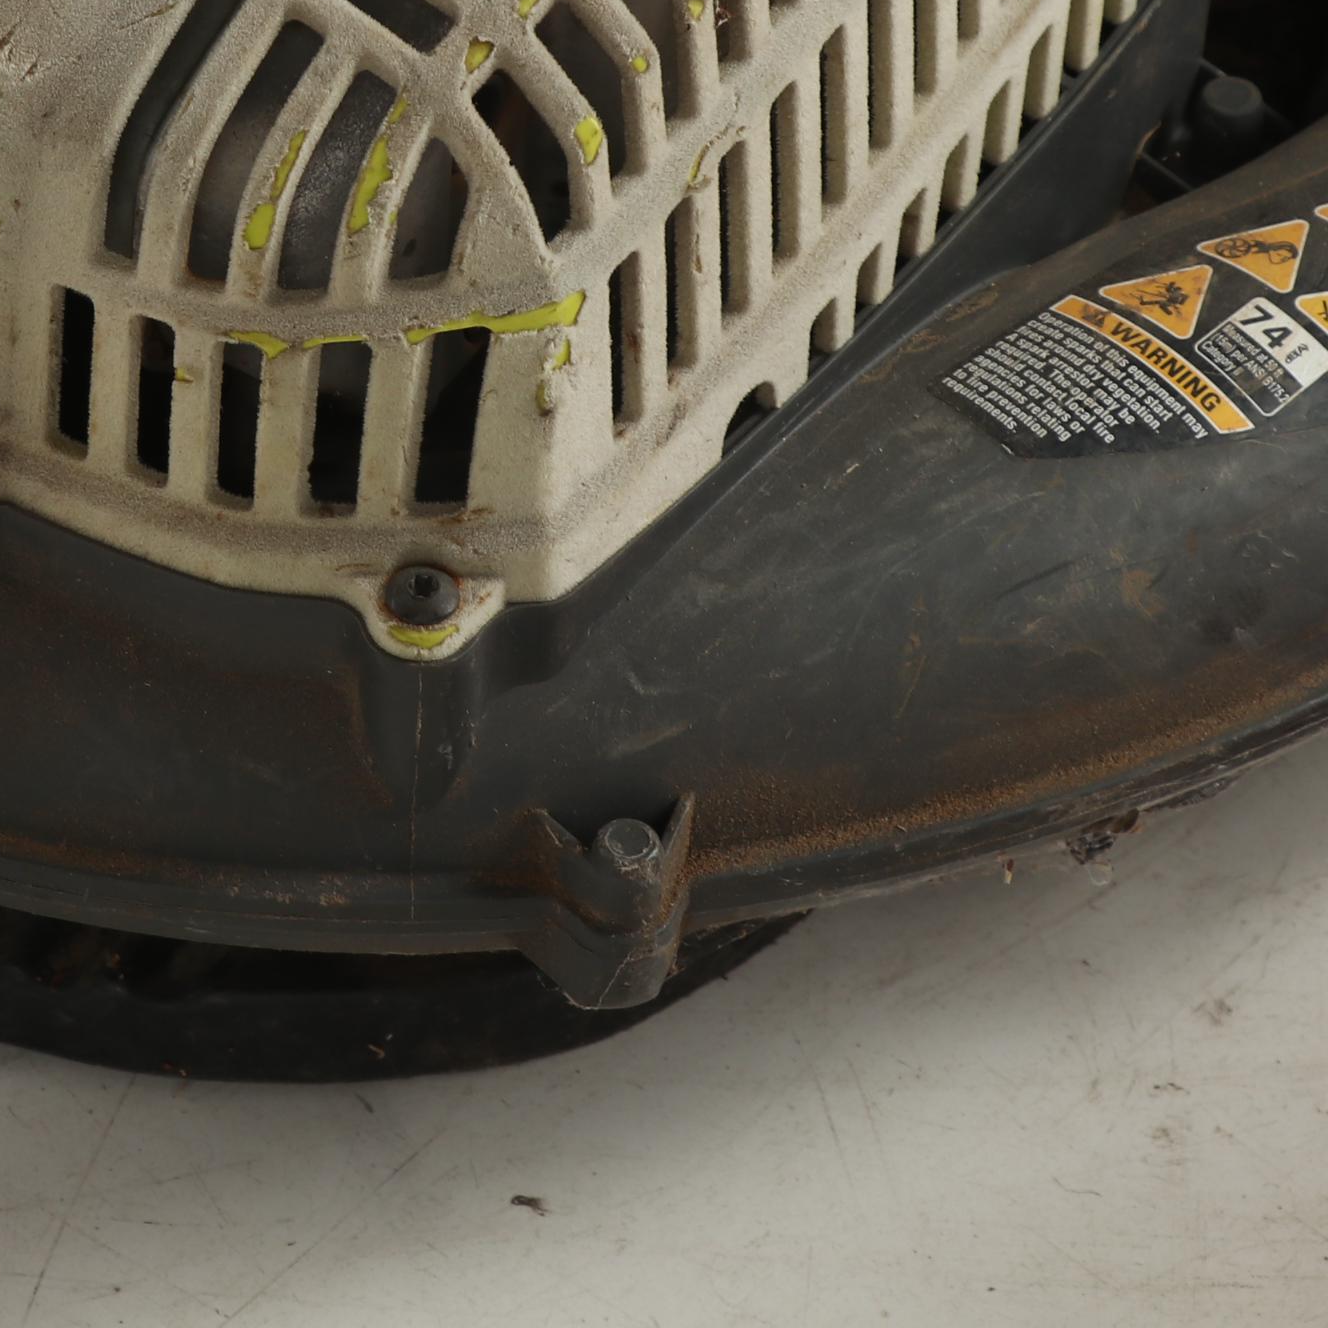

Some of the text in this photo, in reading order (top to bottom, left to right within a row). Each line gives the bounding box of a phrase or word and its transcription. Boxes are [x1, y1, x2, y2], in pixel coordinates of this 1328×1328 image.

[1110, 322, 1221, 412] WARNING
[1202, 341, 1236, 372] Category
[1239, 304, 1293, 349] 74
[942, 377, 1017, 433] requirements.
[953, 368, 1047, 437] to fire prevention
[963, 362, 1071, 442] regulations relating
[974, 355, 1086, 433] agencies for laws or
[985, 348, 1115, 443] should contact local fire
[995, 341, 1119, 427] required. The operator
[1005, 333, 1135, 424] A spark arrestor may be
[1015, 326, 1160, 433] fires around dry vegetation.
[1027, 320, 1173, 421] create sparks that can start
[1038, 312, 1208, 439] Operation of this equipment may
